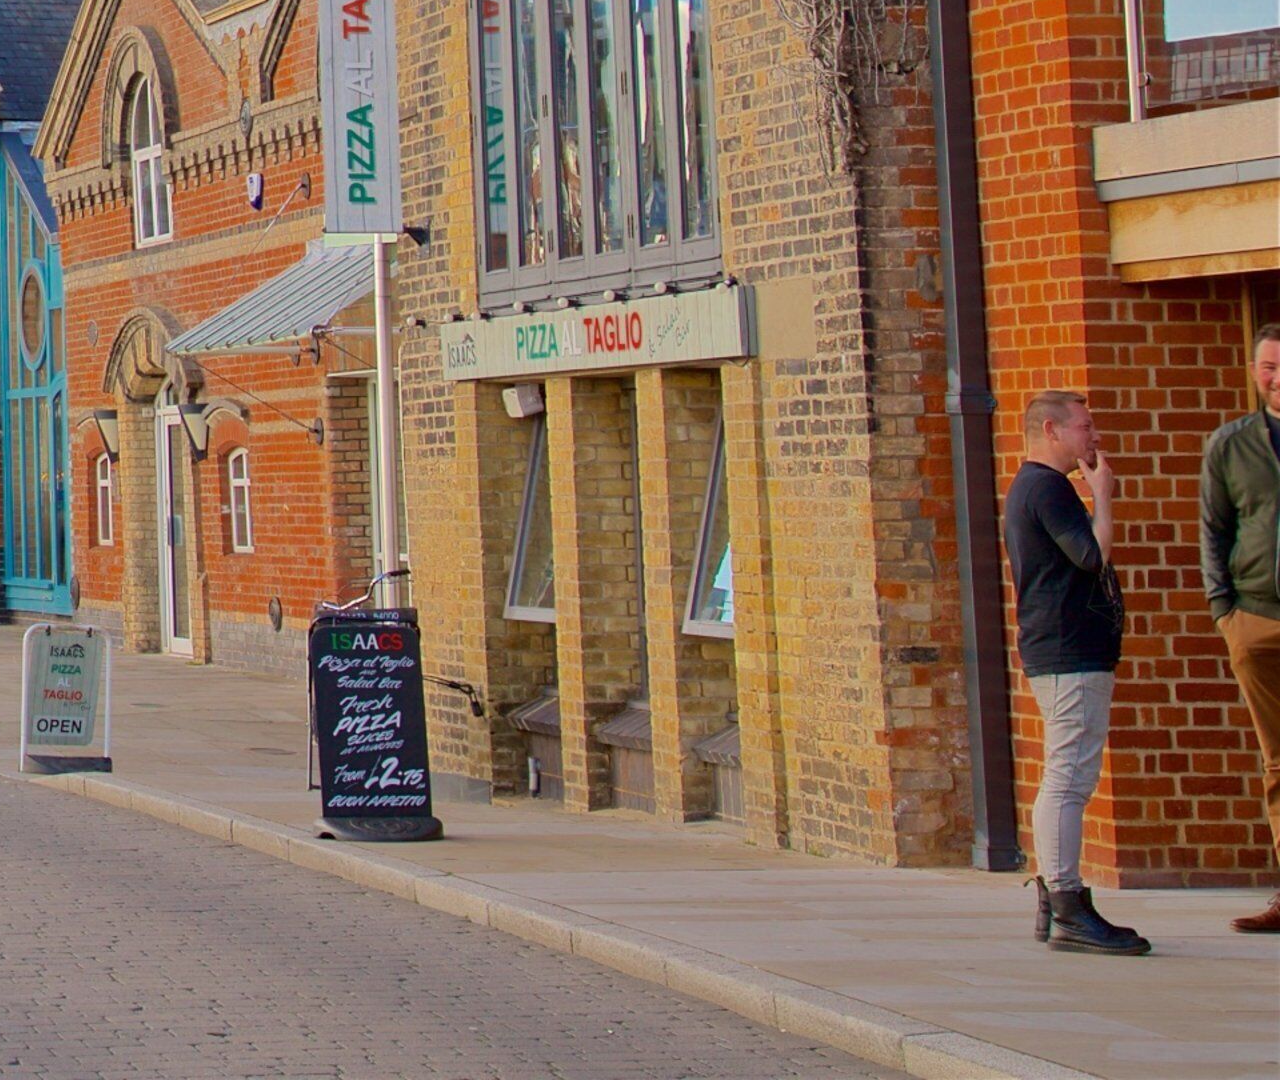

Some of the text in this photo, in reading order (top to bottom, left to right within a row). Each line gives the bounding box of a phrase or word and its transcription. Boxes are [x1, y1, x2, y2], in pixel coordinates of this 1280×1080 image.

[345, 49, 375, 98] AL
[345, 103, 377, 204] PIZZA
[447, 311, 643, 369] ISAACS PIZZA AL TAGLIO
[331, 633, 404, 650] ISAACS
[50, 646, 85, 658] ISAACS
[51, 664, 82, 674] PIZZA
[318, 654, 362, 672] Pizza
[380, 655, 415, 673] Taglio
[57, 678, 71, 688] AL
[337, 675, 403, 689] Salad Bar
[43, 689, 83, 701] TAGLIO
[339, 694, 393, 716] Fresh
[36, 718, 82, 734] OPEN
[332, 710, 401, 736] PIZZA
[347, 729, 394, 746] SLICES
[327, 794, 427, 808] BUON APPETITO
